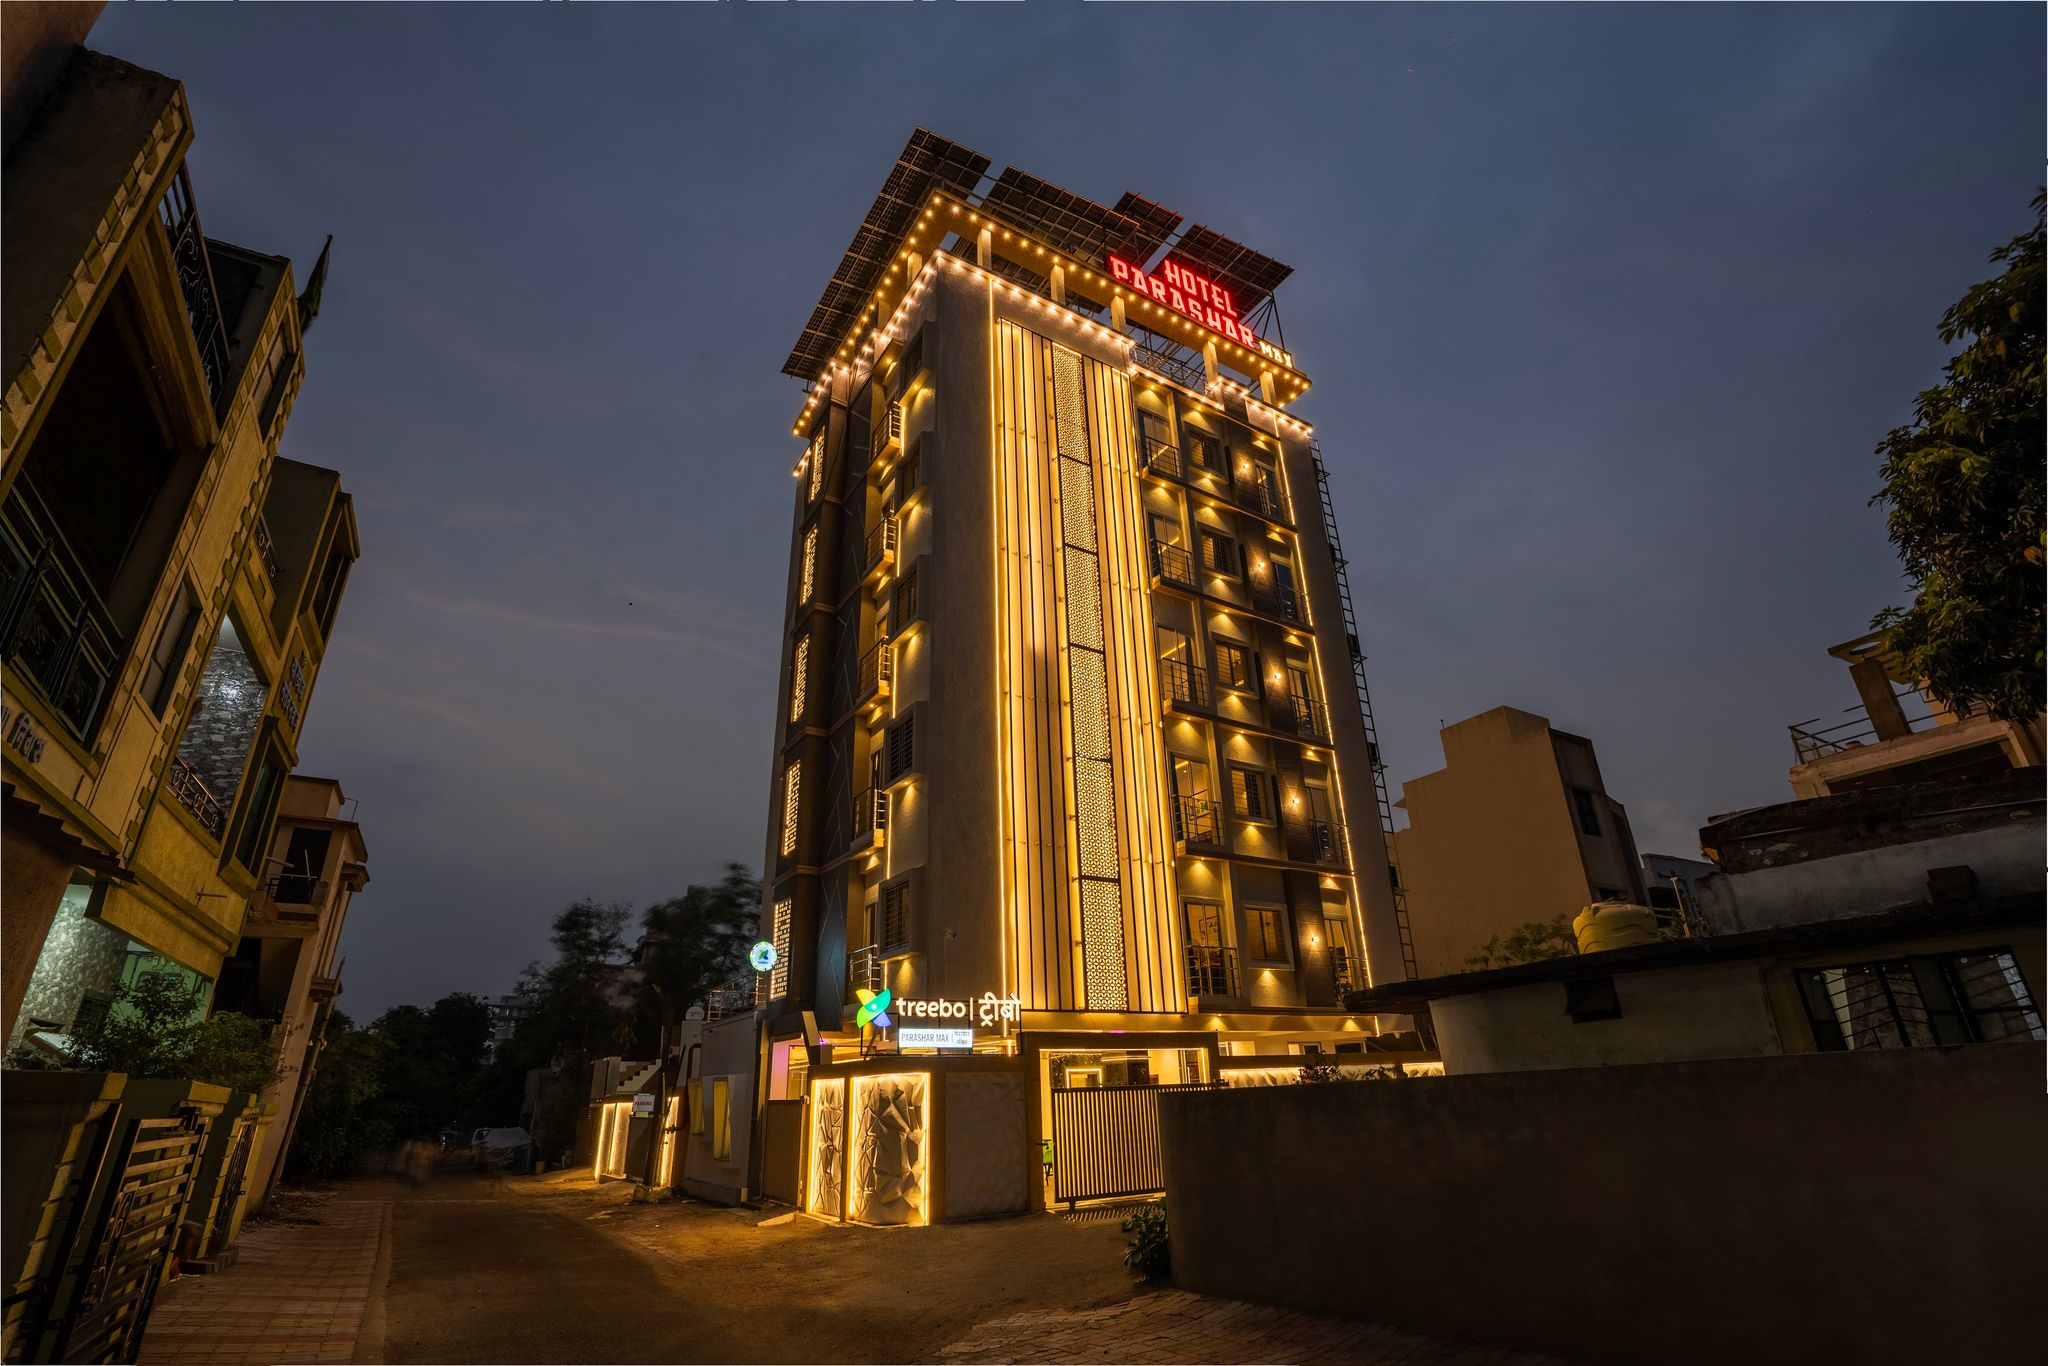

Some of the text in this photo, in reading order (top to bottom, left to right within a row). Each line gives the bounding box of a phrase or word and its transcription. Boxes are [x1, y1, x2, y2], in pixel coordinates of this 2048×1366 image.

[1164, 259, 1238, 317] HOTEL
[1110, 256, 1292, 368] PARASHAR MAX
[895, 992, 1022, 1027] treebo ट्रीबो
[901, 1033, 934, 1042] PARASHAR
[936, 1034, 949, 1042] MAX
